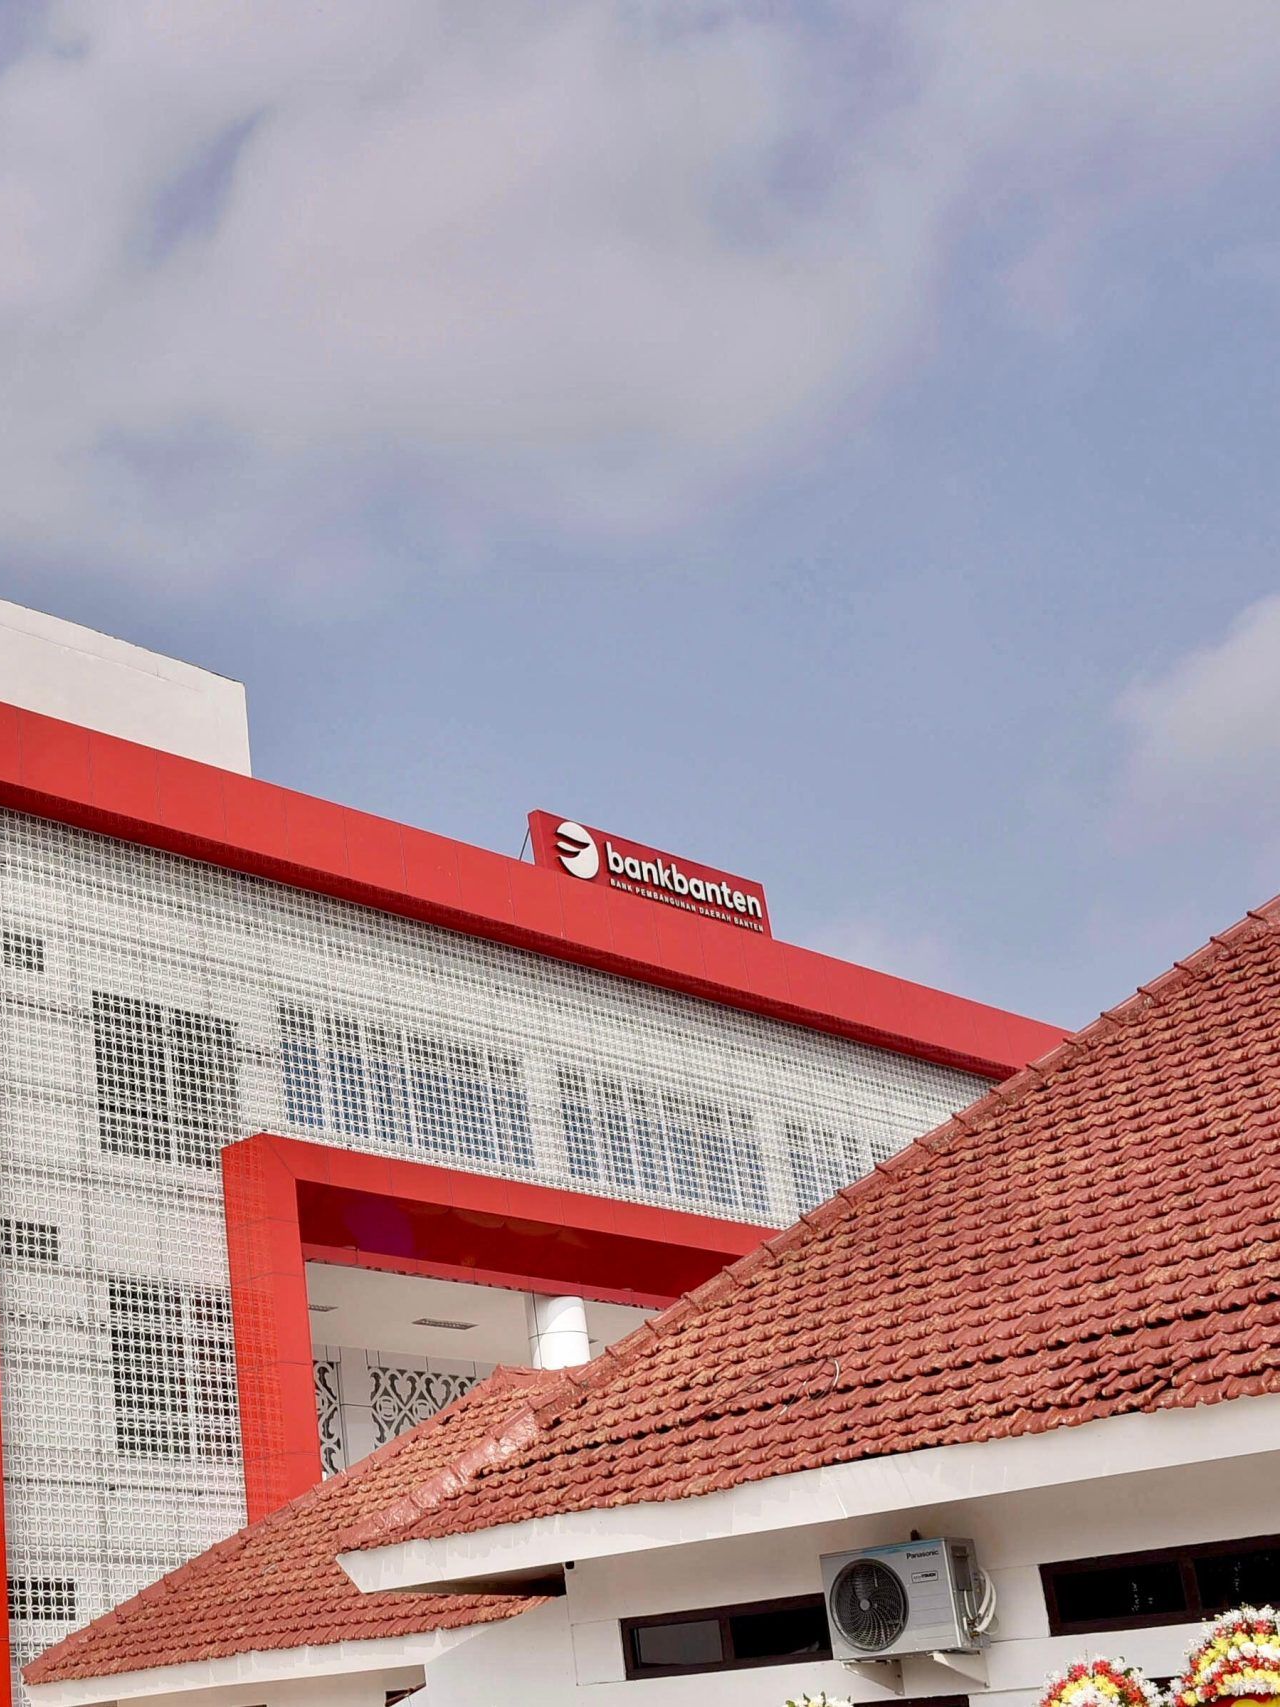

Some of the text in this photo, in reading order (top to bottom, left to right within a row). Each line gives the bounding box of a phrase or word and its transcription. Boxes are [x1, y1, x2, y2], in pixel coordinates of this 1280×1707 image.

[605, 841, 763, 919] bankbanten
[610, 878, 764, 933] BANK PEMBANGUNAN DAERAH BANTEN
[906, 1549, 939, 1560] Panasonic
